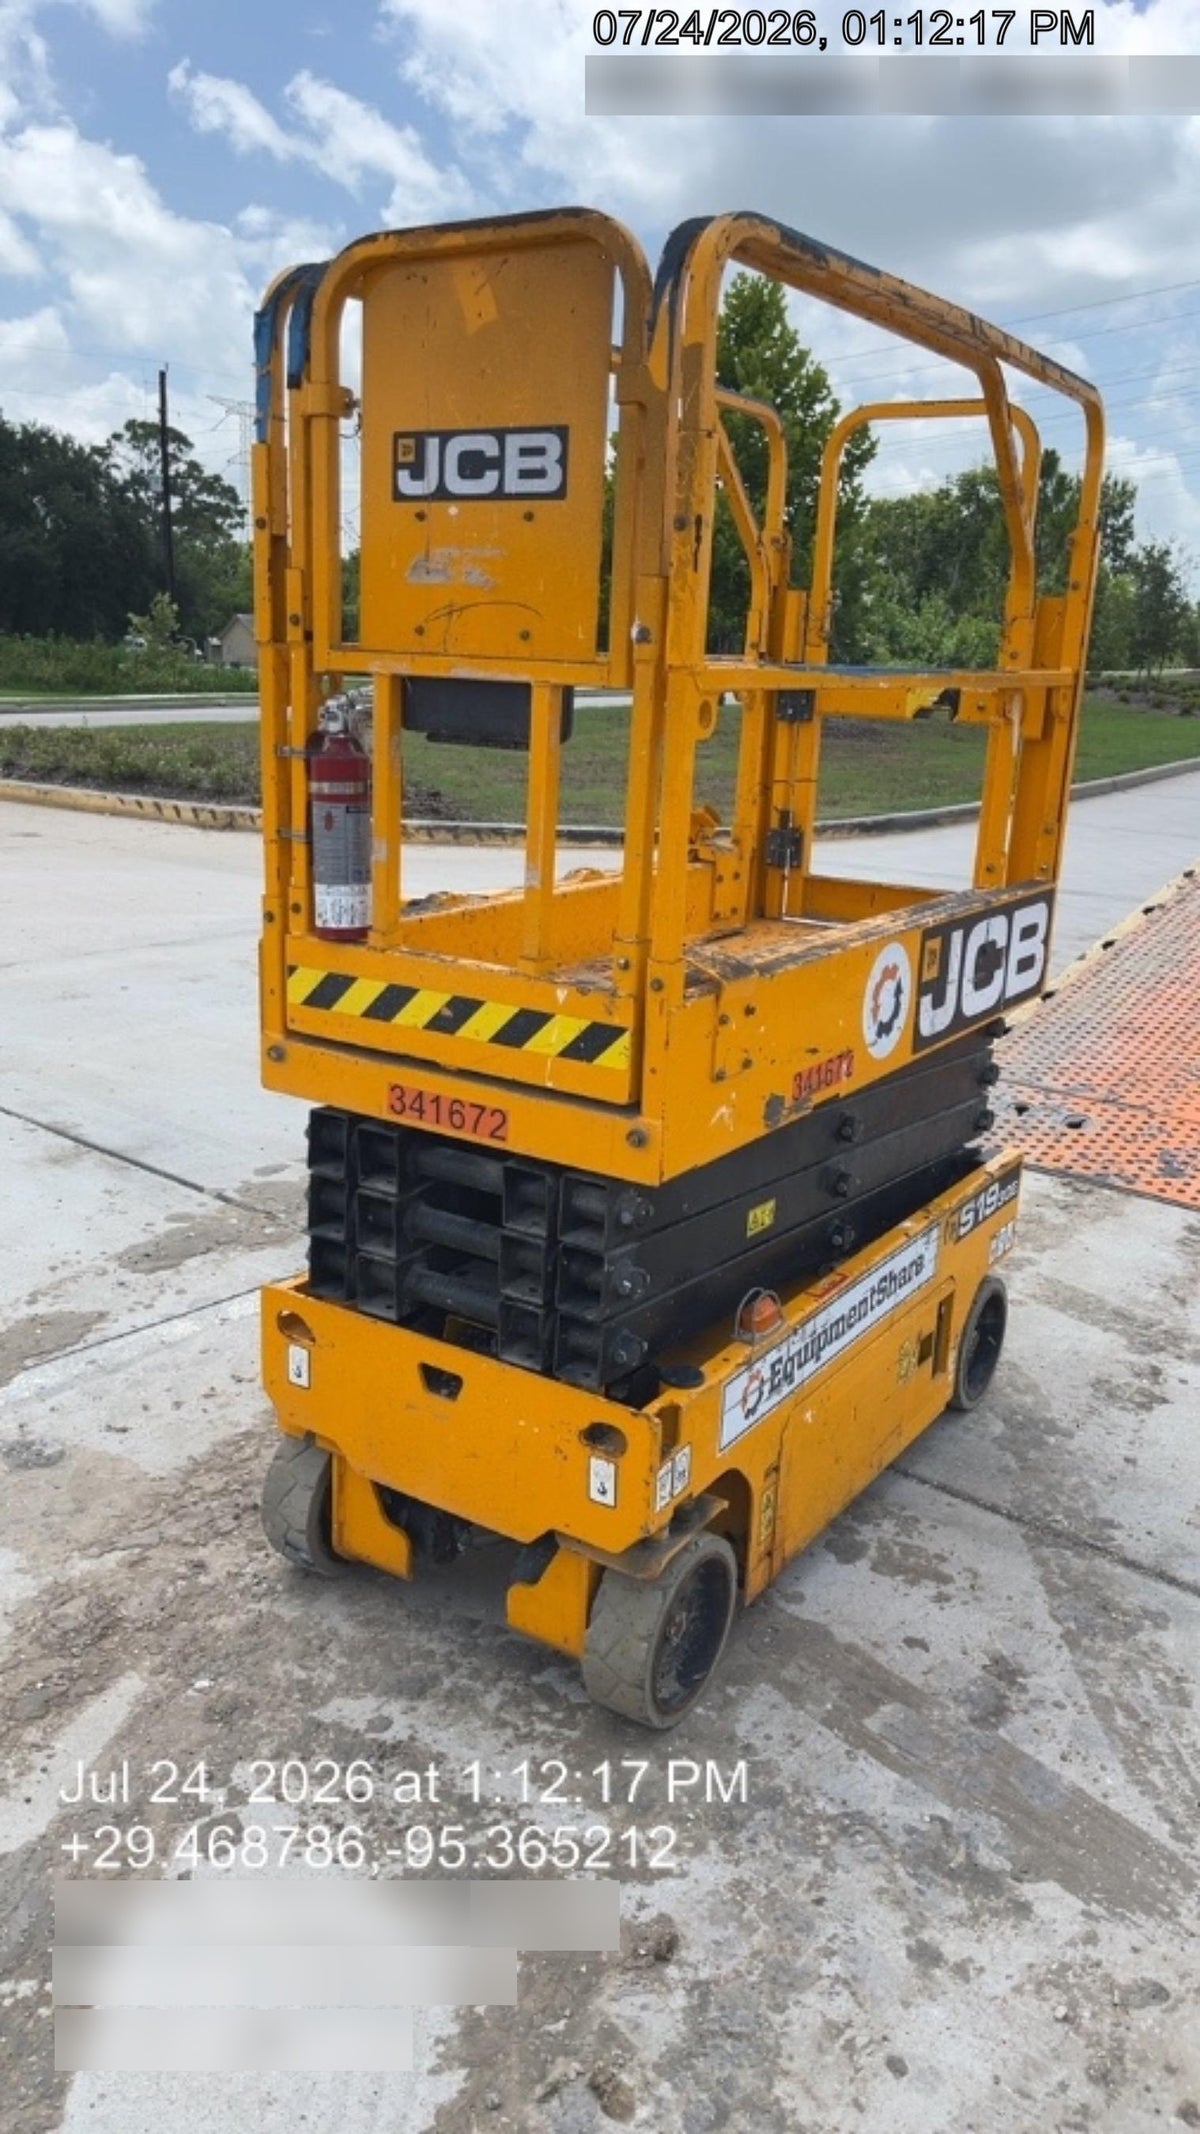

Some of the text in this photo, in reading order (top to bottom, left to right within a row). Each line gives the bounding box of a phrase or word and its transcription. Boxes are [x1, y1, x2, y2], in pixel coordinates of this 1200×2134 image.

[397, 432, 562, 496] JCB
[919, 902, 1048, 1037] JCB
[792, 1049, 854, 1101] 341672
[390, 1084, 507, 1141] 341672
[768, 1254, 925, 1394] EquipmentShare
